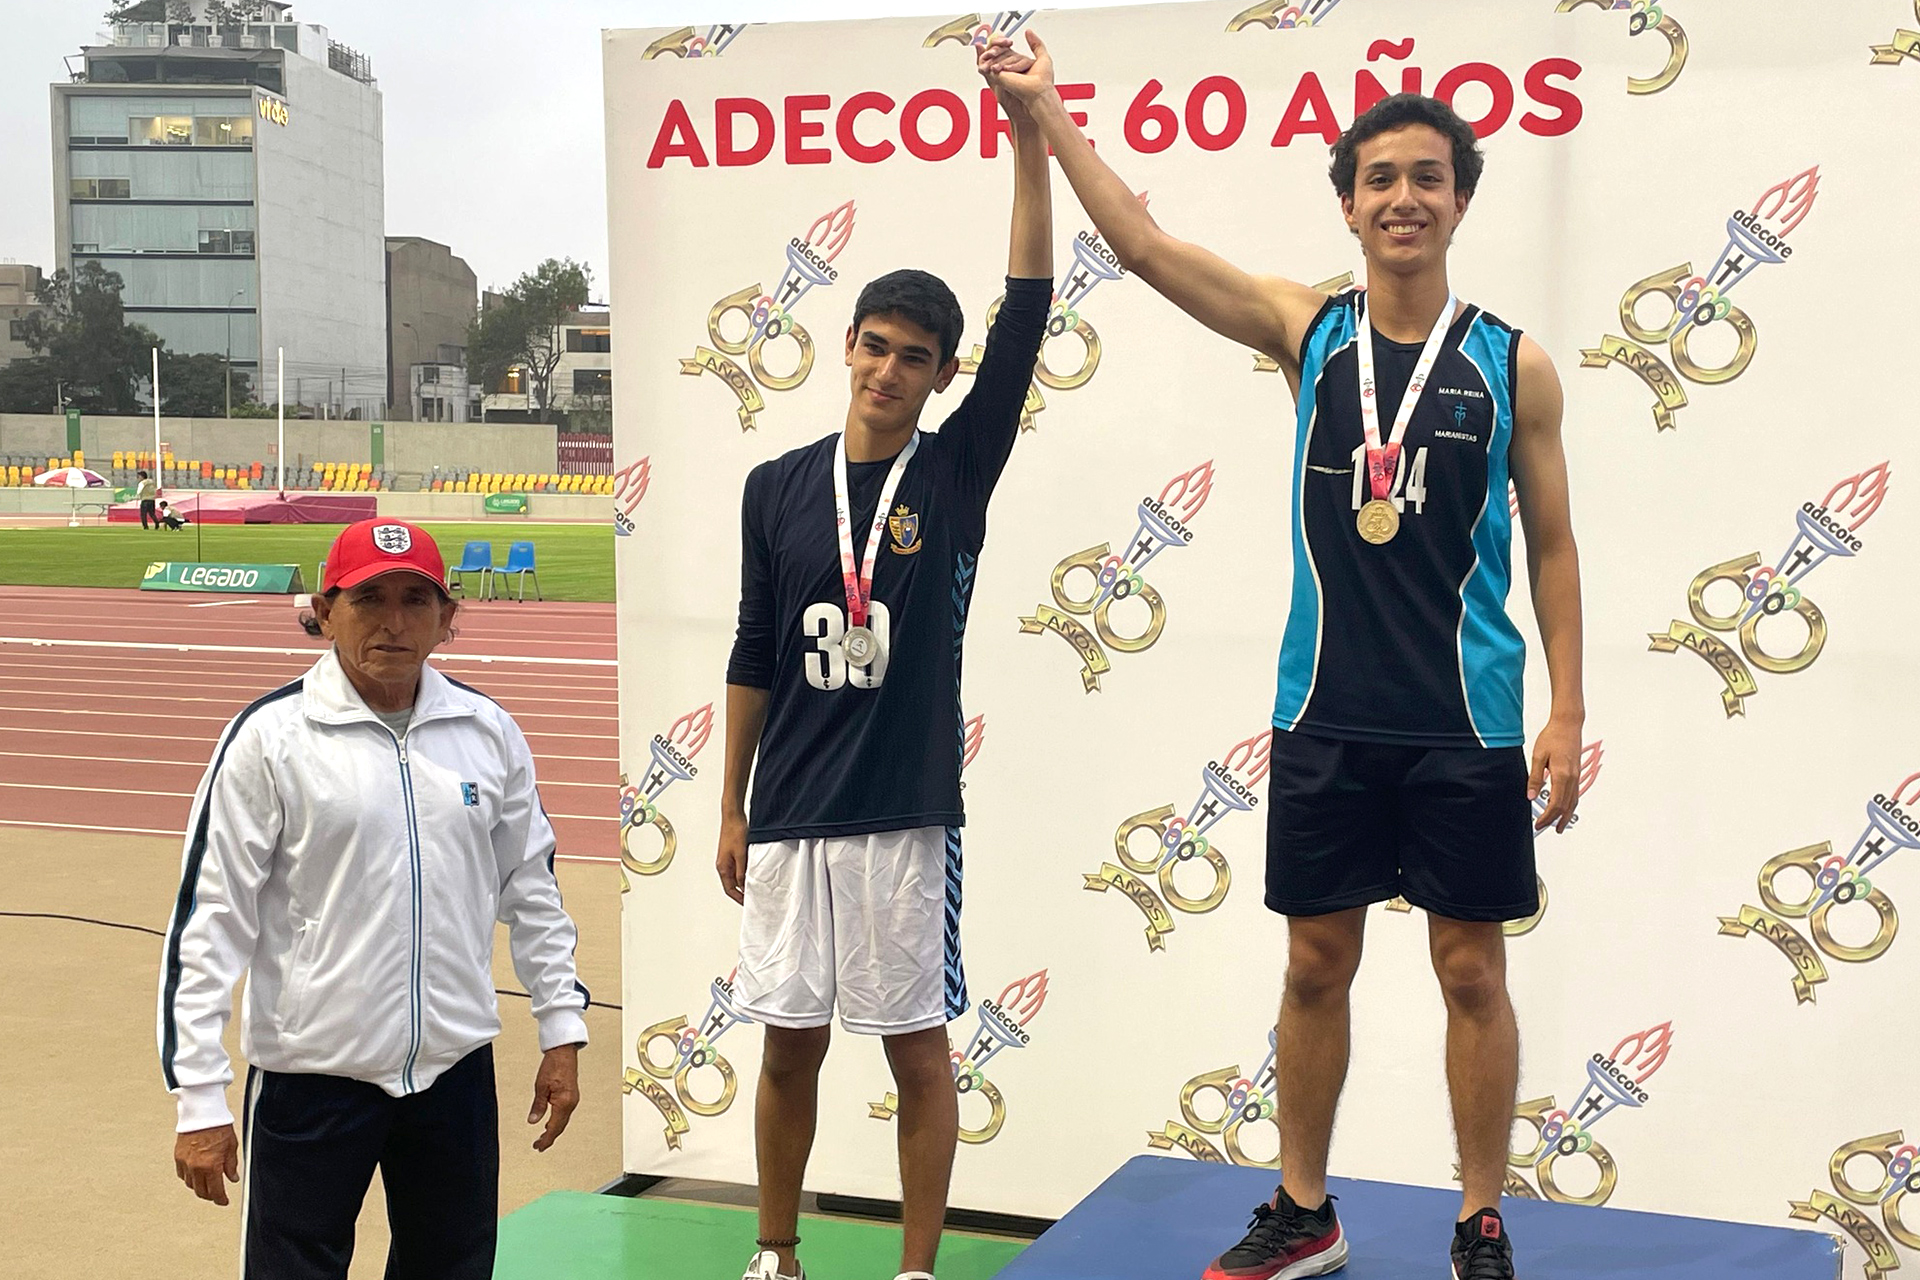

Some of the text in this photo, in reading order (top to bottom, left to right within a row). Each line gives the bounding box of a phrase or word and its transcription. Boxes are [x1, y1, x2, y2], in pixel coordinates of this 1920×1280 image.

[1123, 75, 1247, 154] 60
[1270, 37, 1583, 148] AÑOS
[1078, 230, 1128, 275] adecore
[1732, 209, 1793, 259] adecore
[790, 236, 838, 281] adecore
[705, 356, 755, 401] AÑOS
[1438, 387, 1461, 396] MARIA
[1614, 345, 1676, 397] AÑOS
[1142, 496, 1194, 542] adecore
[1802, 501, 1863, 553] adecore
[1047, 615, 1100, 662] AÑOS
[1681, 631, 1745, 684] AÑOS
[654, 733, 699, 777] adecore
[1207, 760, 1259, 807] adecore
[1873, 793, 1920, 838] adeco
[1112, 873, 1165, 921] AÑOS
[1752, 917, 1816, 971] AÑOS
[982, 998, 1031, 1045] adecore
[635, 1078, 681, 1123] AÑOS
[1592, 1052, 1649, 1104] adecore
[1177, 1133, 1220, 1162] AÑ
[1824, 1203, 1888, 1257] AÑOS
